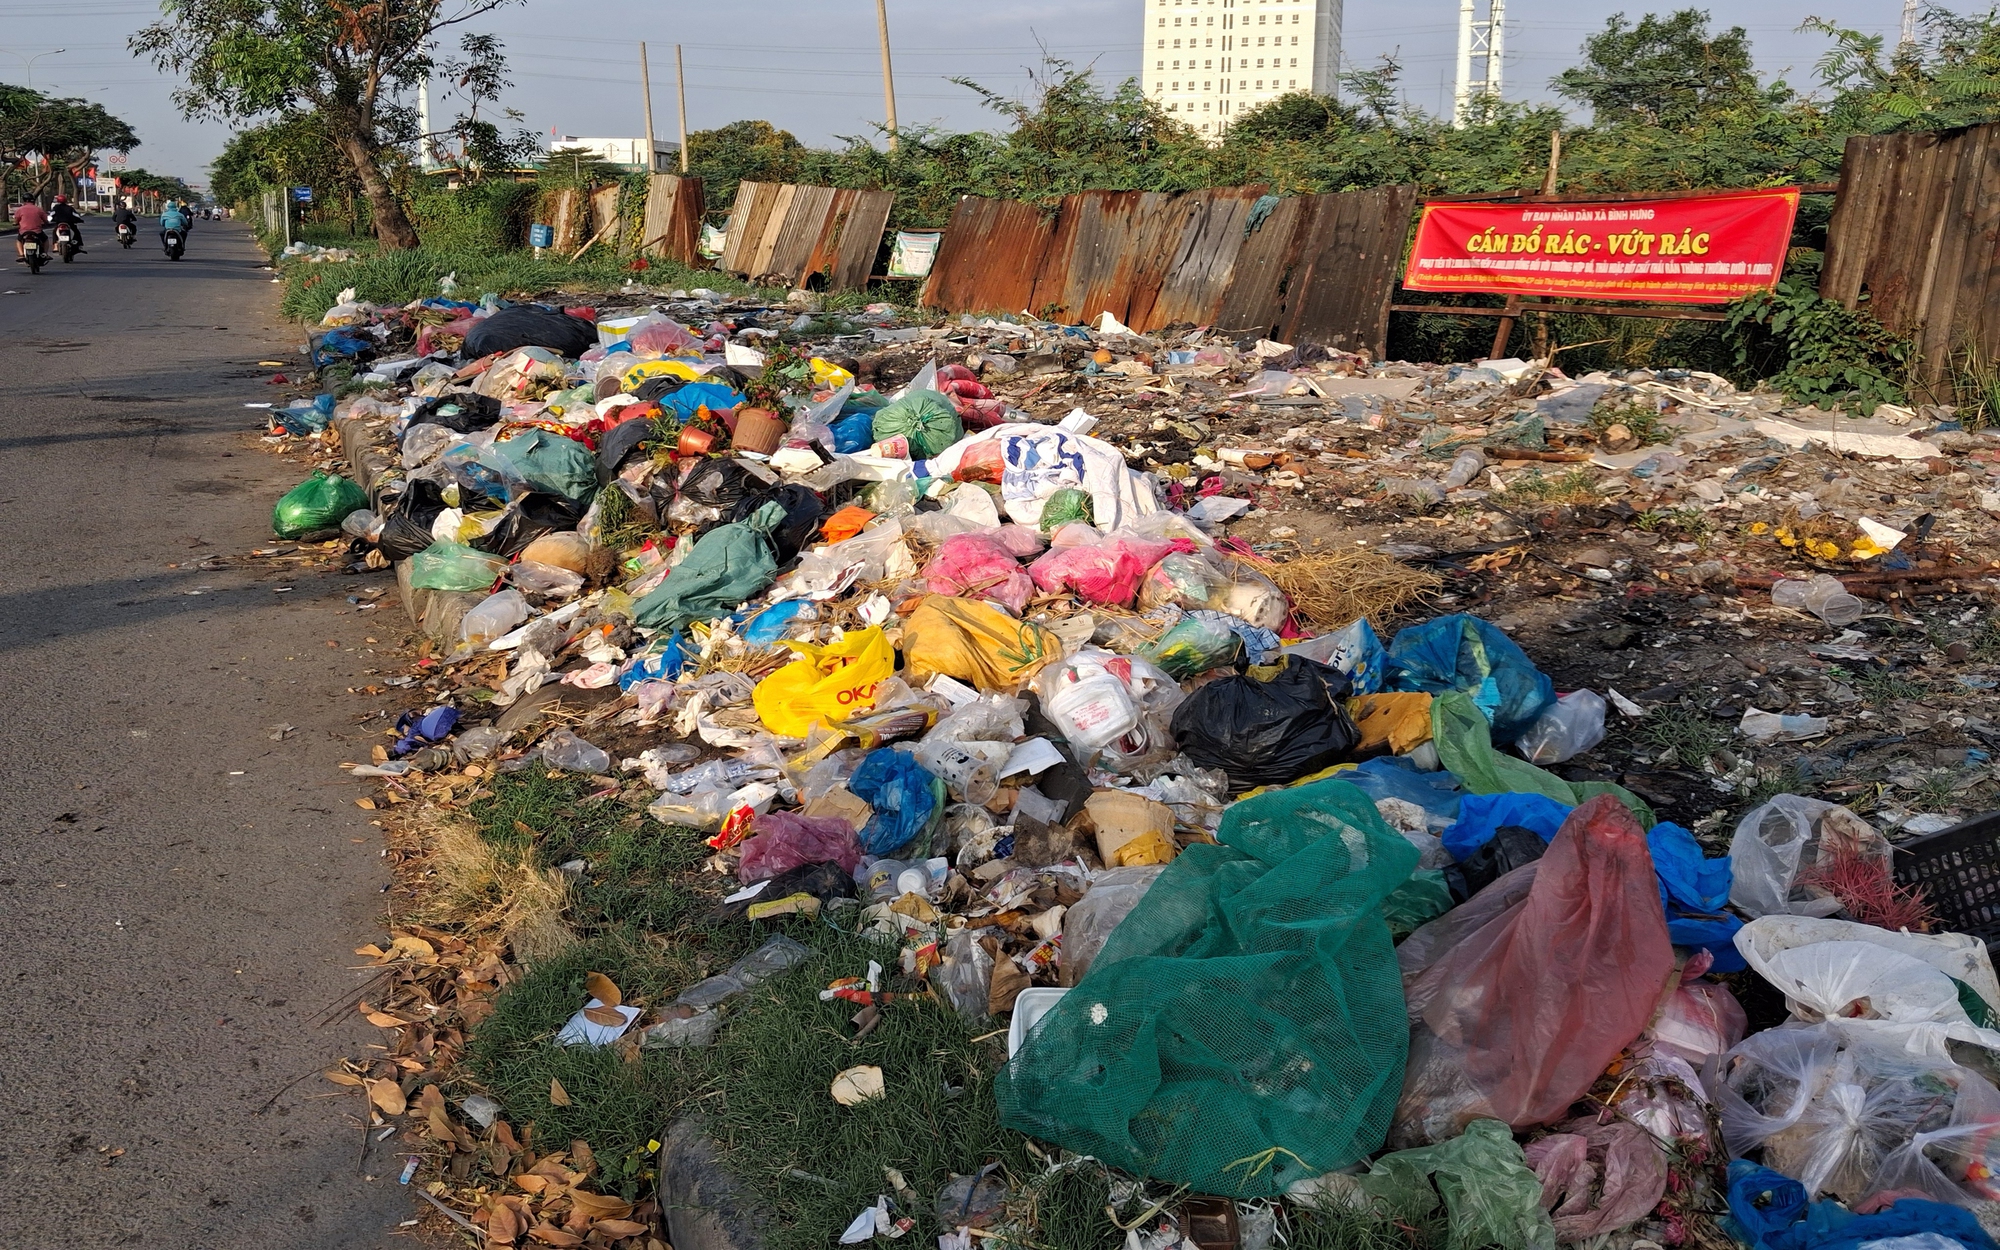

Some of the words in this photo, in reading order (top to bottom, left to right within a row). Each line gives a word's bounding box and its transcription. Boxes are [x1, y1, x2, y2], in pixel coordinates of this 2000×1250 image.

[1533, 212, 1550, 221] BAN
[1551, 209, 1574, 221] NHÂN
[1575, 209, 1593, 221] DÂN
[1608, 208, 1628, 221] BÌNH
[1467, 226, 1509, 253] CẤM
[1510, 223, 1544, 254] ĐỔ
[1544, 228, 1592, 254] RÁC
[1607, 228, 1655, 255] VỨT
[1658, 227, 1710, 255] RÁC
